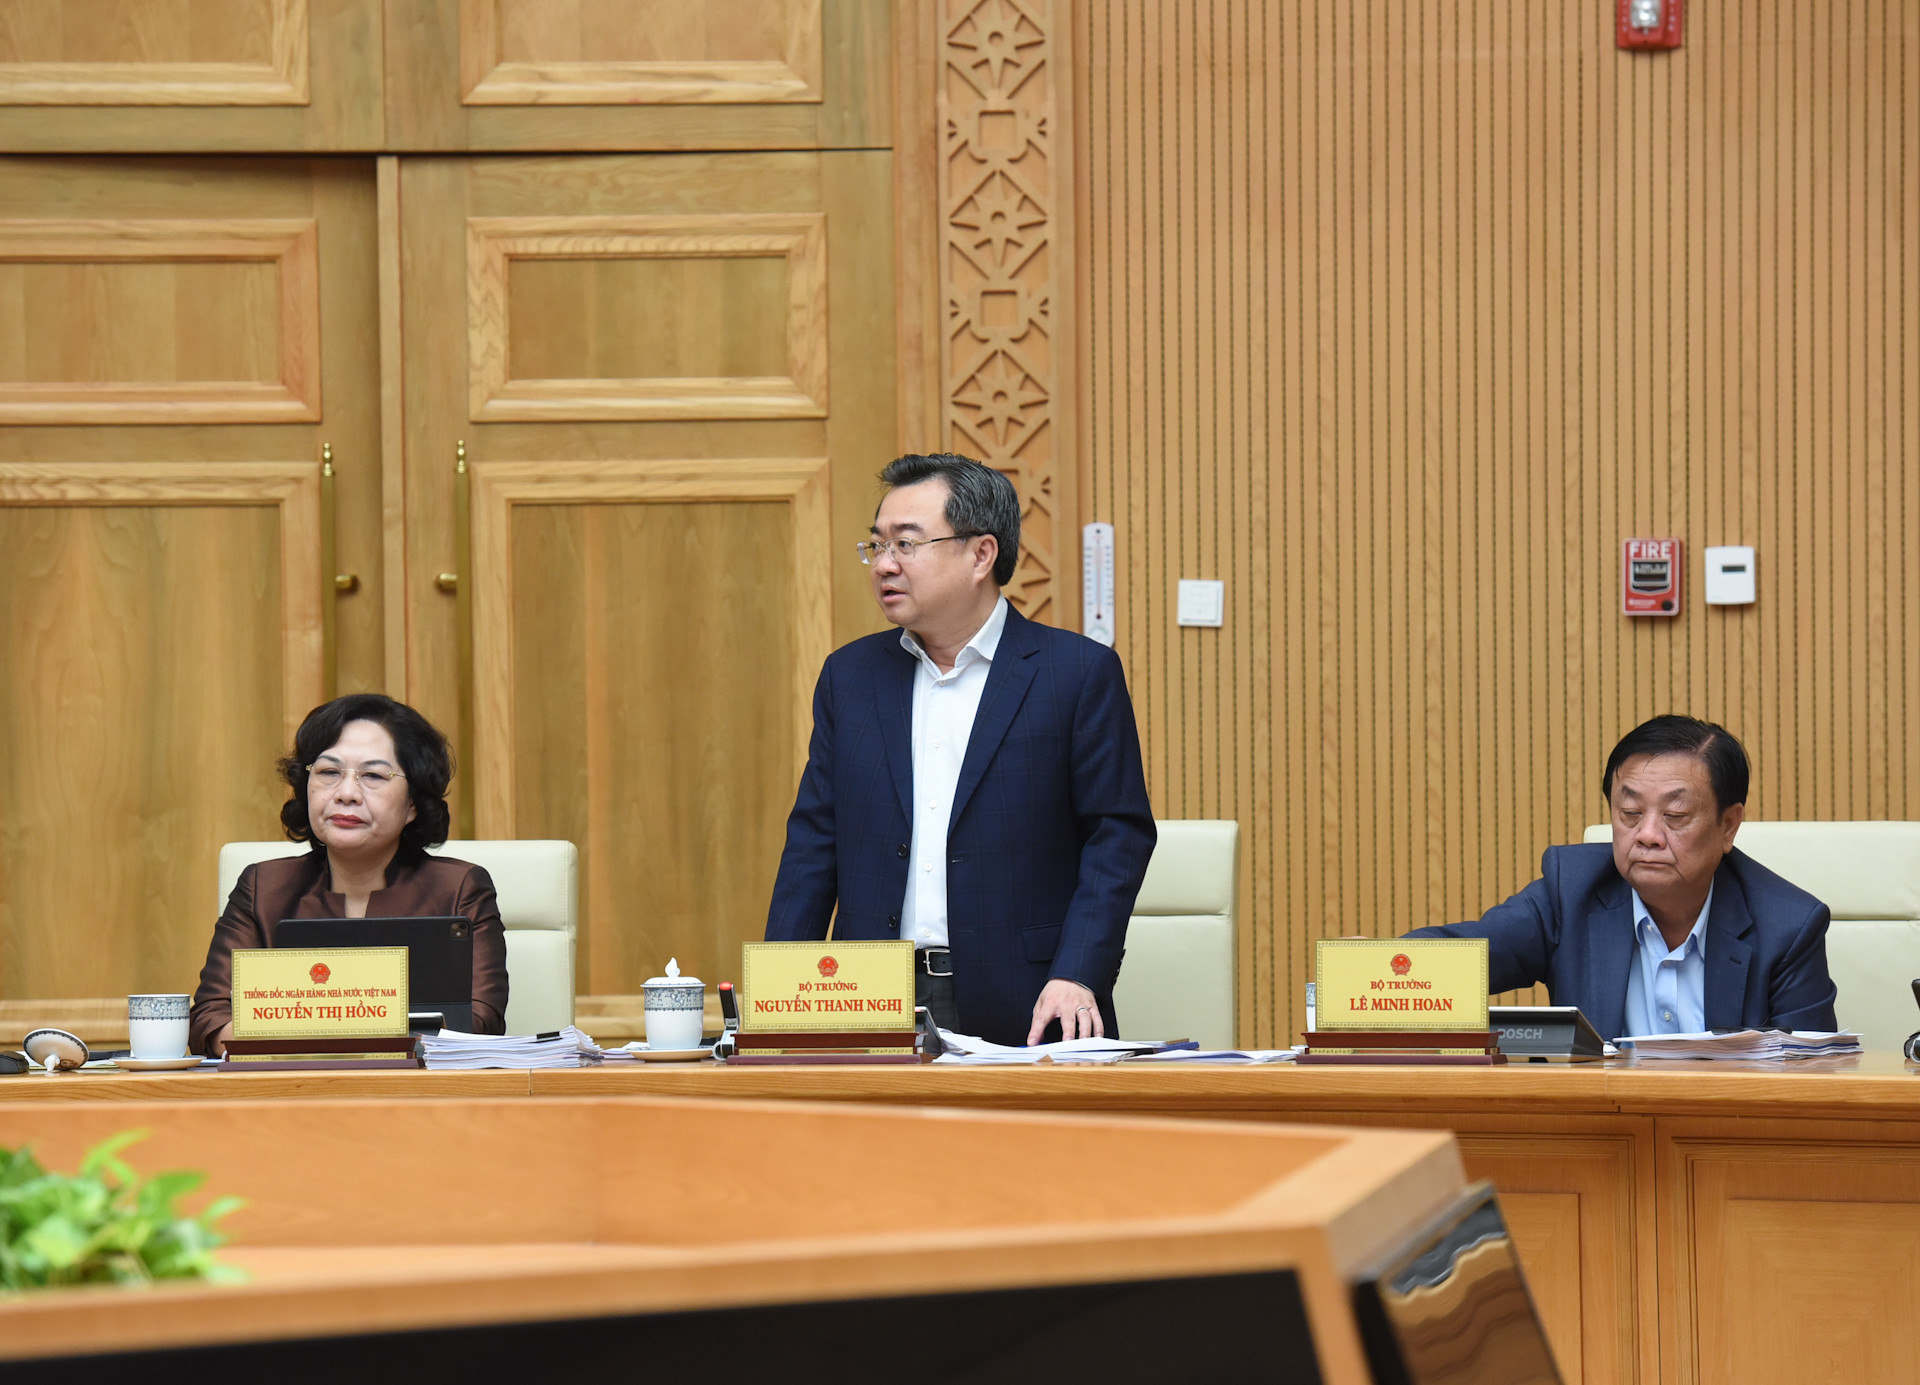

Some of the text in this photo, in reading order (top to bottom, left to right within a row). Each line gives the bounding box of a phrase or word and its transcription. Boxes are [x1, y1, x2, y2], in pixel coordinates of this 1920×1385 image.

[1629, 541, 1672, 559] FIRE
[243, 987, 397, 999] THỐNG ĐỐC NGÂN HÀNG NHÀ NƯỚC VIỆT NAM
[798, 980, 858, 993] BỘ TRƯỞNG
[1370, 979, 1432, 991] BỘ TRƯỞNG
[253, 1000, 387, 1021] NGUYỄN THỊ HỒNG
[754, 995, 903, 1014] NGUYỄN THANH NGHỊ
[1350, 995, 1453, 1011] LÊ MINH HOAN
